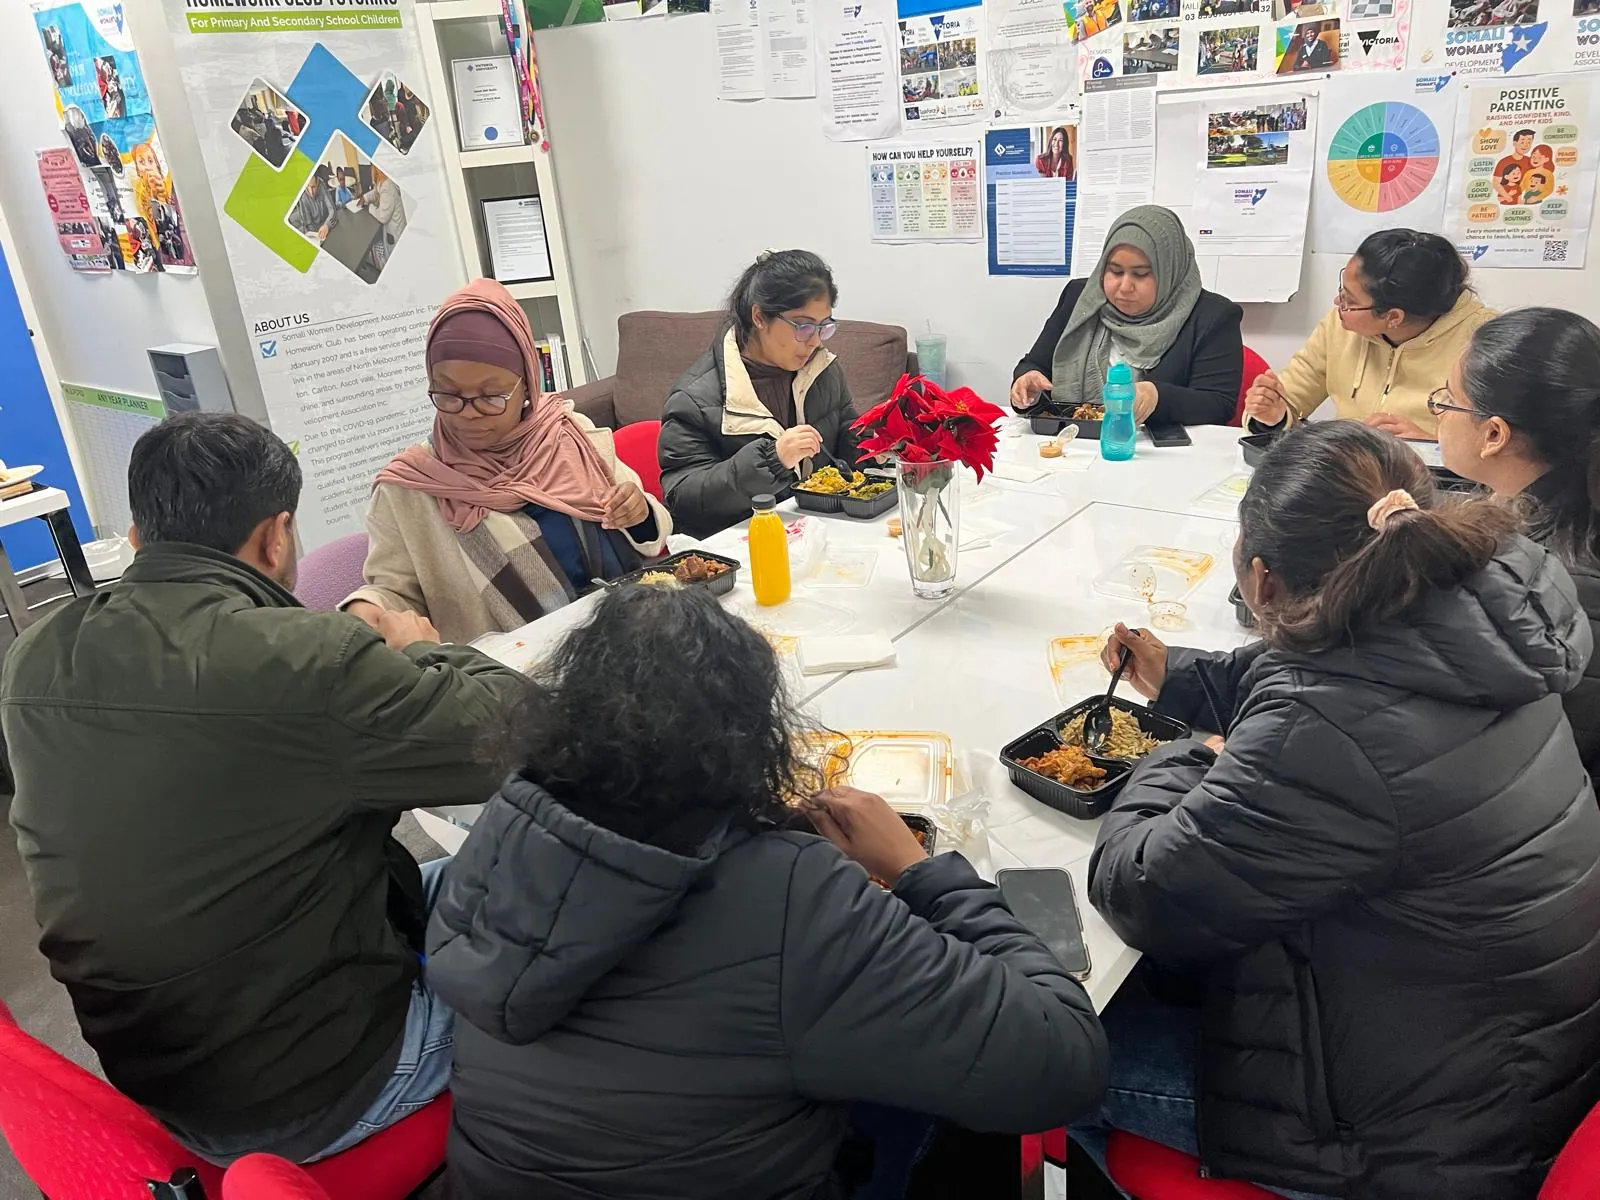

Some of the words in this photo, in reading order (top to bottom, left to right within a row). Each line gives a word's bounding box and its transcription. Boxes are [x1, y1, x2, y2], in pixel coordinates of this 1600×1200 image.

[191, 17, 208, 28] For
[211, 17, 248, 30] Primary
[250, 16, 270, 27] And
[272, 16, 325, 28] Secondary
[327, 15, 360, 25] School
[360, 14, 399, 24] Children
[1360, 37, 1399, 46] VICTORIA
[1446, 28, 1504, 45] SOMALI
[1445, 43, 1503, 57] WOMAN'S
[1445, 58, 1499, 68] DEVELOPMENT
[1500, 87, 1559, 100] POSITIVE
[1490, 99, 1565, 113] PARENTING
[872, 152, 887, 161] HOW
[888, 151, 901, 160] CAN
[902, 150, 916, 160] YOU
[917, 149, 934, 159] HELP
[936, 147, 973, 158] YOURSELF?
[255, 316, 291, 334] ABOUT
[293, 313, 310, 325] US
[282, 331, 305, 342] Somali
[307, 326, 334, 337] Women
[336, 316, 379, 331] Development
[381, 309, 414, 322] Association
[285, 343, 323, 356] Homework
[325, 338, 342, 348] Club
[359, 332, 375, 341] been
[378, 326, 408, 338] operating
[321, 354, 338, 364] 2007
[340, 351, 352, 360] and
[379, 343, 401, 351] service
[402, 336, 422, 346] offered
[314, 371, 326, 380] the
[326, 367, 345, 377] areas
[345, 364, 353, 372] of
[354, 359, 372, 370] North
[340, 378, 358, 388] Ascot
[377, 368, 403, 379] Moonee
[321, 398, 335, 407] and
[336, 389, 374, 403] surrounding
[403, 379, 414, 387] the
[108, 396, 122, 405] YEAR
[121, 398, 149, 410] PLANNER
[303, 413, 340, 426] velopment
[340, 403, 377, 417] Association
[304, 433, 319, 442] Due
[342, 420, 374, 432] COVID-19
[307, 442, 337, 454] changed
[346, 433, 366, 443] online
[377, 426, 395, 436] zoom
[311, 458, 325, 466] This
[326, 449, 354, 463] program
[354, 442, 380, 453] delivers
[380, 437, 401, 447] regular
[313, 468, 335, 479] online
[336, 464, 347, 472] via
[348, 459, 367, 470] zoom
[316, 477, 346, 490] qualified
[320, 487, 352, 502] academic
[323, 502, 349, 514] student
